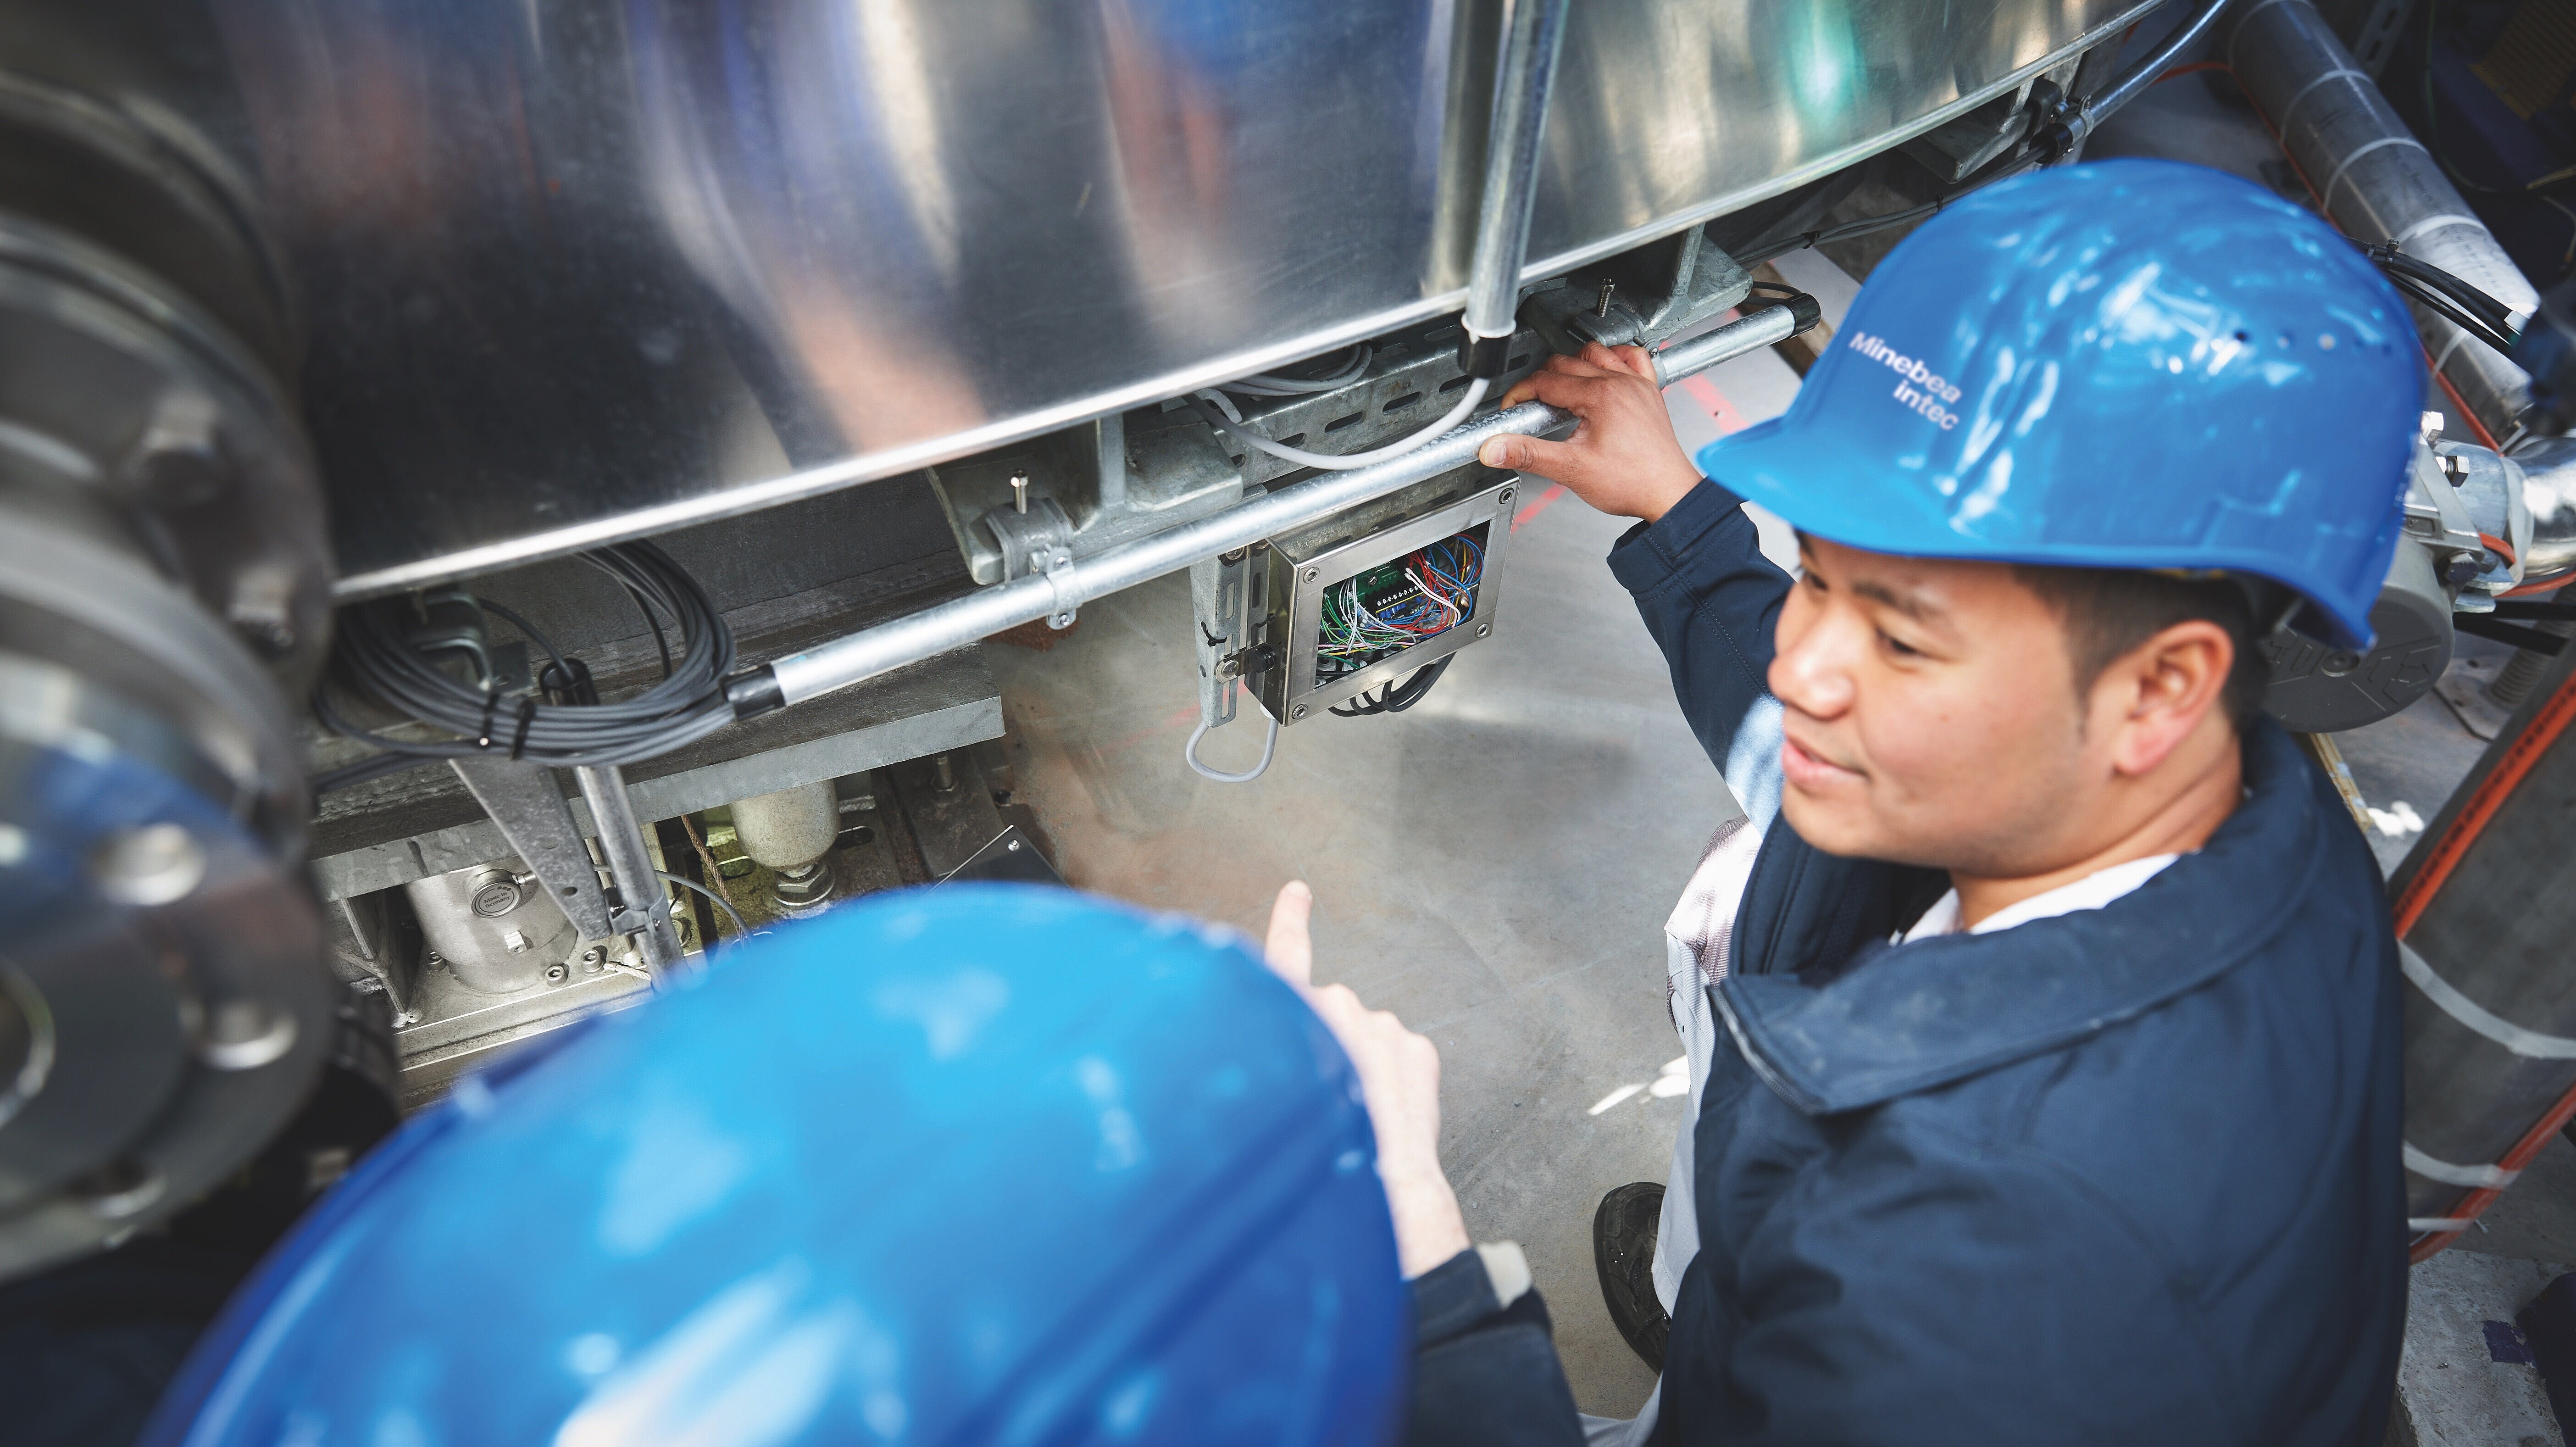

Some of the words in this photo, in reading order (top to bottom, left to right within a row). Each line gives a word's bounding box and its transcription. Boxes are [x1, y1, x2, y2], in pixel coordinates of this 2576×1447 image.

[1849, 331, 1962, 404] Minebea
[1893, 379, 1959, 430] intec
[484, 895, 500, 903] Made
[485, 896, 510, 908] Germany
